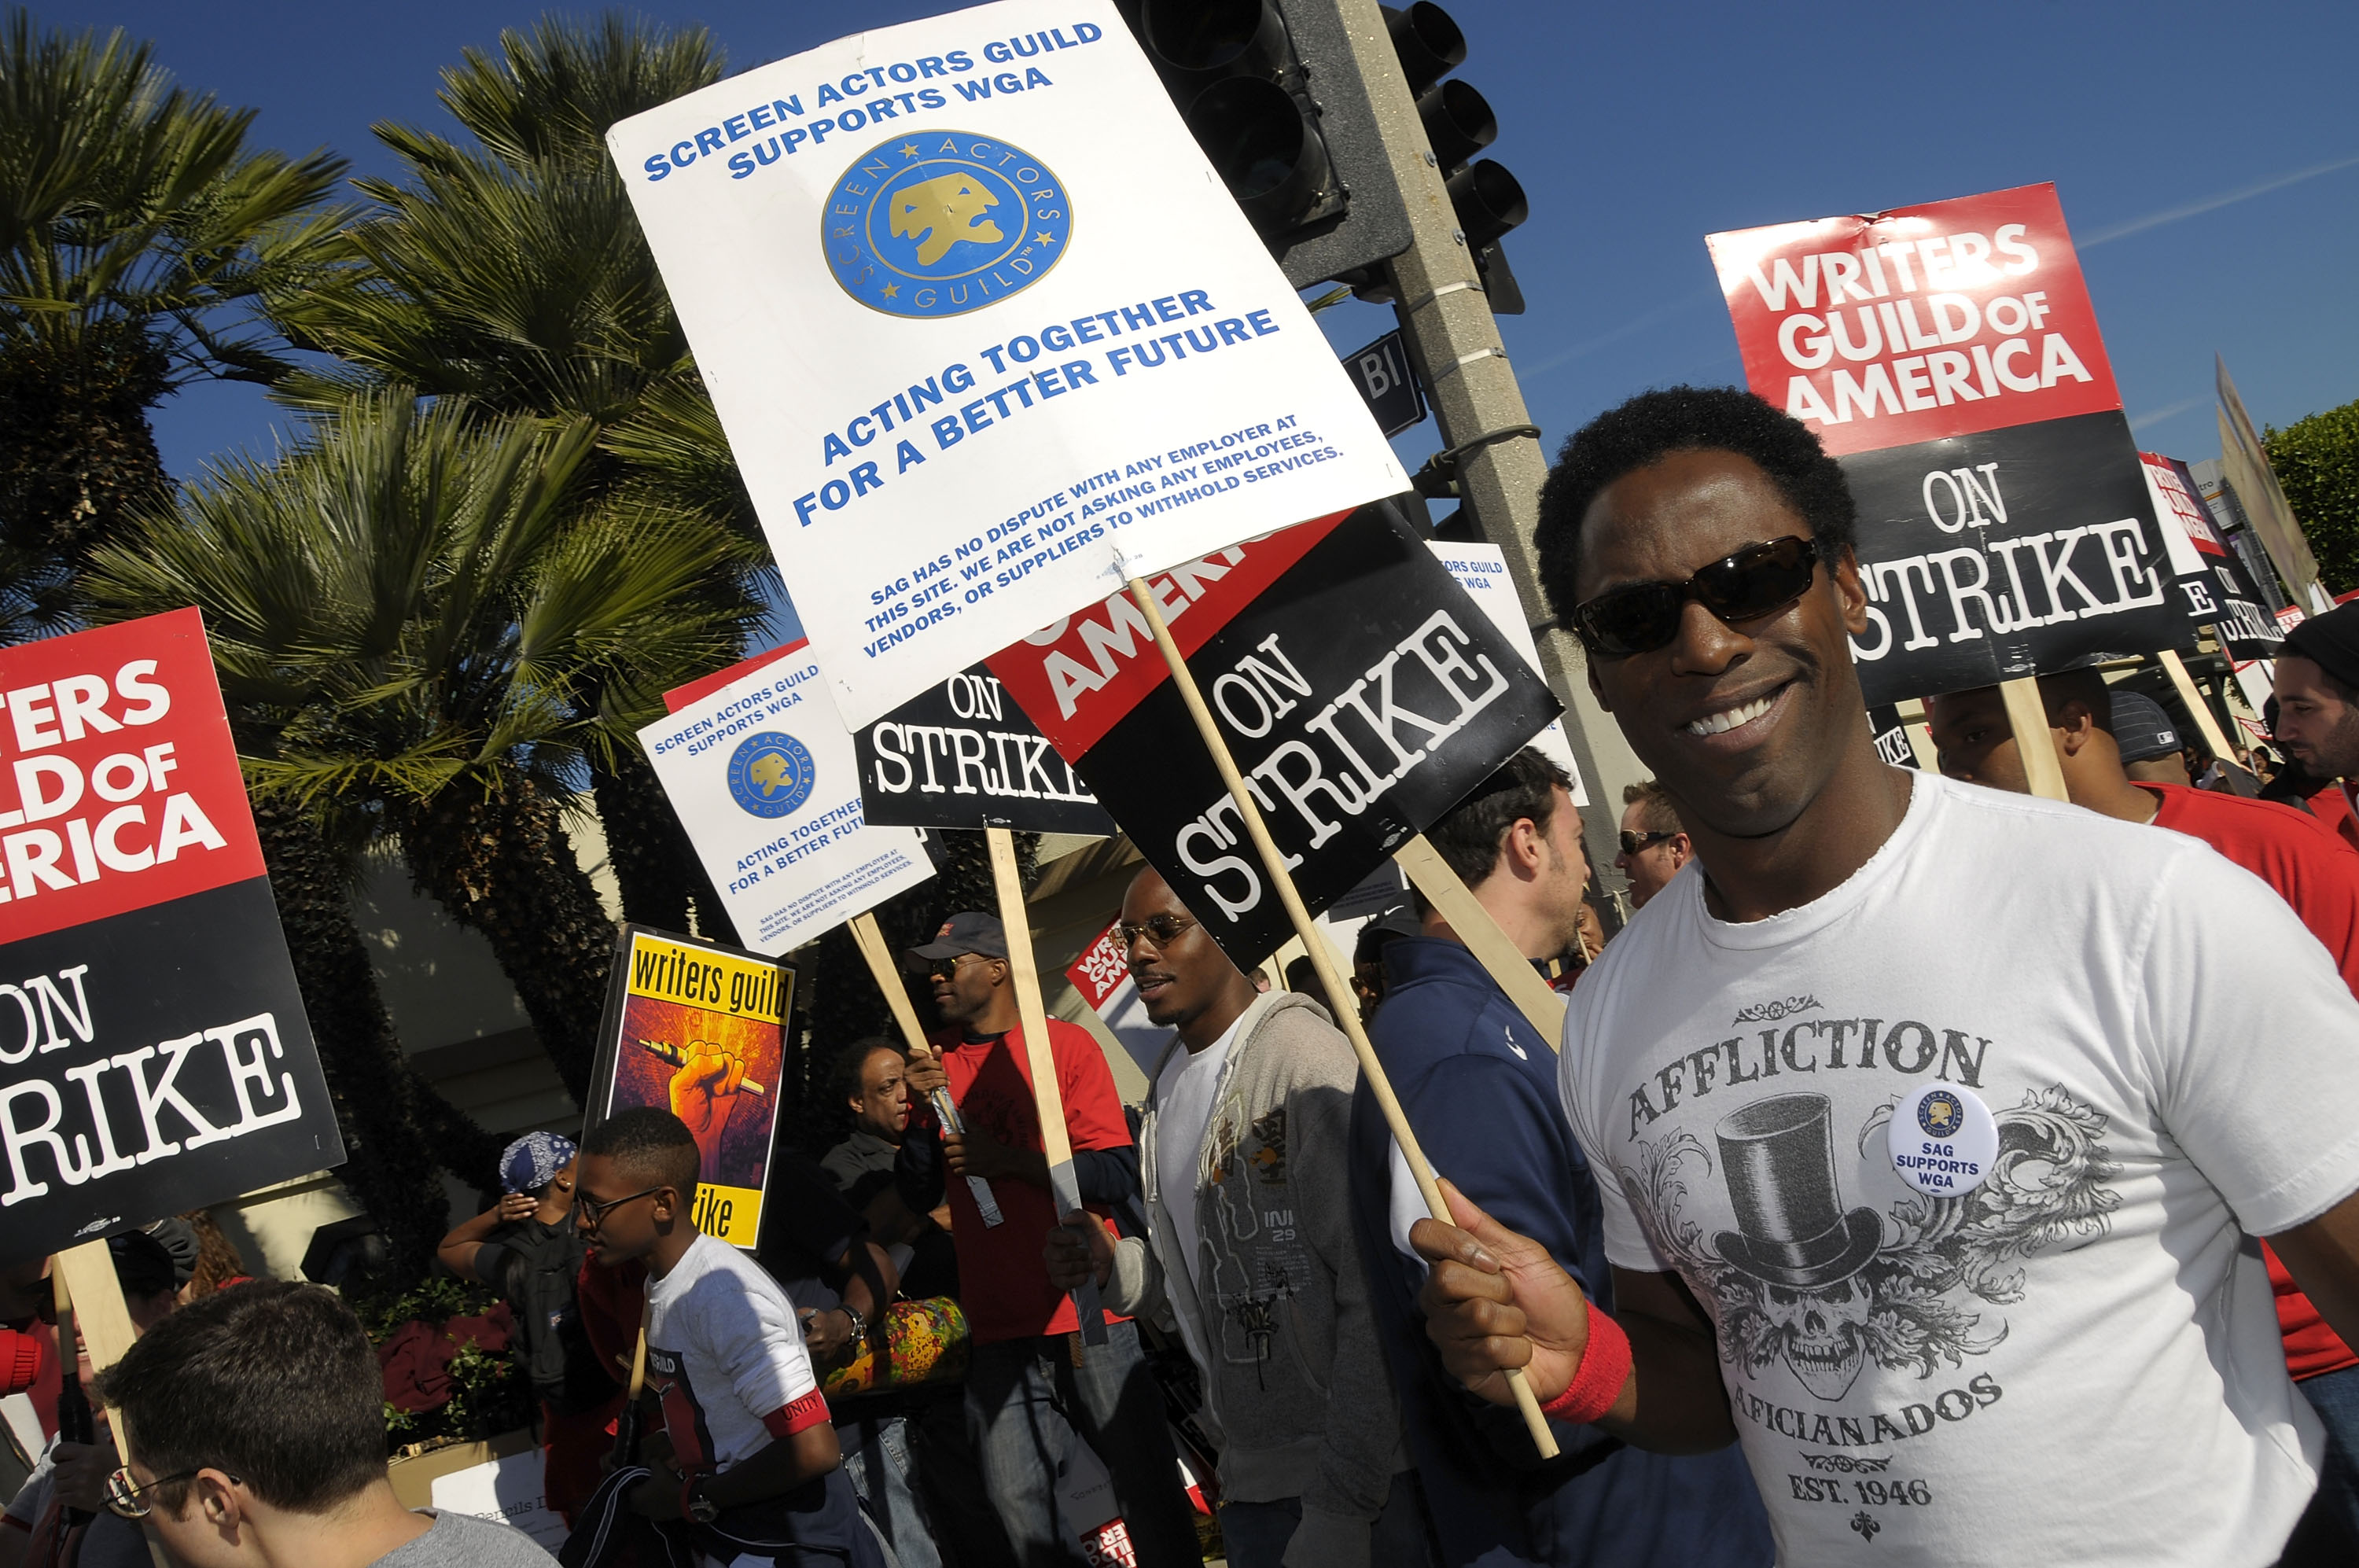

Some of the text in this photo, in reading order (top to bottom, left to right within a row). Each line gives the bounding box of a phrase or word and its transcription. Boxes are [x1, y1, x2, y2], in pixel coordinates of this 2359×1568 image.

[644, 23, 1102, 182] SCREEN ACTORS GUILD
[728, 67, 1053, 179] SUPPORTS WGA
[939, 138, 1059, 220] ACTORS
[1748, 224, 2040, 312] WRITERS
[1777, 292, 2052, 370] GUILD OF
[823, 289, 1215, 466] ACTING TOGETHER
[1786, 333, 2094, 426] AMERICA
[793, 309, 1279, 527] FOR A BETTER FUTURE
[866, 432, 1324, 632] THIS SITE. WE ARE NOT ASKING ANY EMPLOYEES,
[871, 414, 1296, 605] SAG HAS NO DISPUTE WITH ANY EMPLOYER AT
[1923, 462, 2008, 534] ON
[864, 447, 1344, 657] VENDORS, OR SUPPLIERS TO WITHHOLD SERVICES.
[1463, 577, 1492, 589] WGA
[1470, 561, 1503, 573] GUILD
[1847, 518, 2166, 664] STRIKE
[653, 664, 821, 756] SCREEN ACTORS GUILD
[686, 691, 804, 757] SUPPORTS WGA
[947, 673, 1003, 722] ON
[1213, 633, 1313, 739] ON
[91, 741, 178, 804] OF
[1176, 609, 1511, 922] STRIKE
[728, 870, 762, 896] FOR
[763, 863, 775, 878] A
[775, 833, 831, 870] BETTER
[736, 836, 791, 873] ACTING
[634, 948, 791, 1019] writers guild
[1627, 1018, 1993, 1141] AFFLICTION
[1896, 1154, 1979, 1176] SUPPORTS
[1918, 1172, 1954, 1188] WGA
[1922, 1143, 1954, 1158] SAG
[780, 1395, 819, 1422] UNITY
[1732, 1372, 2004, 1447] AFICIANADOS
[1789, 1474, 1932, 1507] EST. 1946
